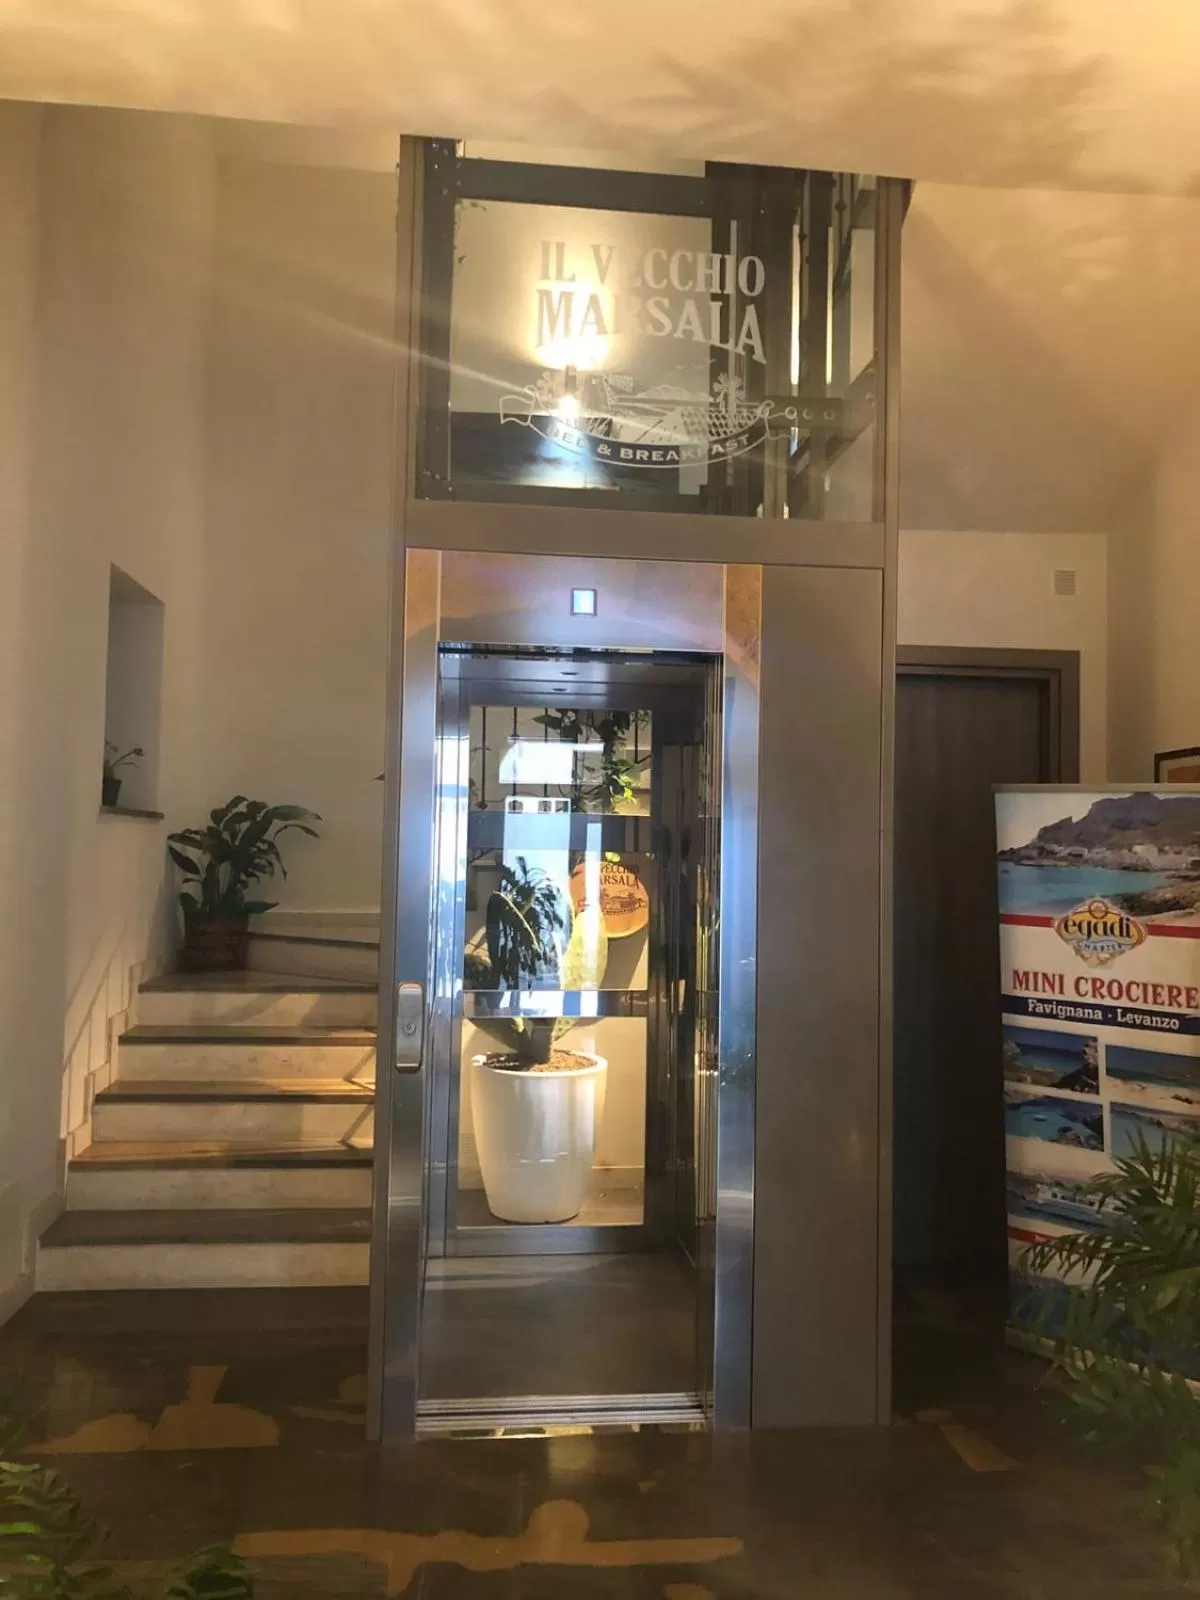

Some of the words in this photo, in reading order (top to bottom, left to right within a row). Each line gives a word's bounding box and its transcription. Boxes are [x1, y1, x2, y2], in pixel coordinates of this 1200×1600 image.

[538, 240, 577, 282] IL
[589, 243, 766, 297] VCCHIO
[596, 442, 612, 457] &
[1012, 969, 1066, 996] MINI
[1074, 976, 1200, 1010] CROCIERE
[1027, 999, 1103, 1019] Favignana
[1117, 1008, 1180, 1031] Levanzo
